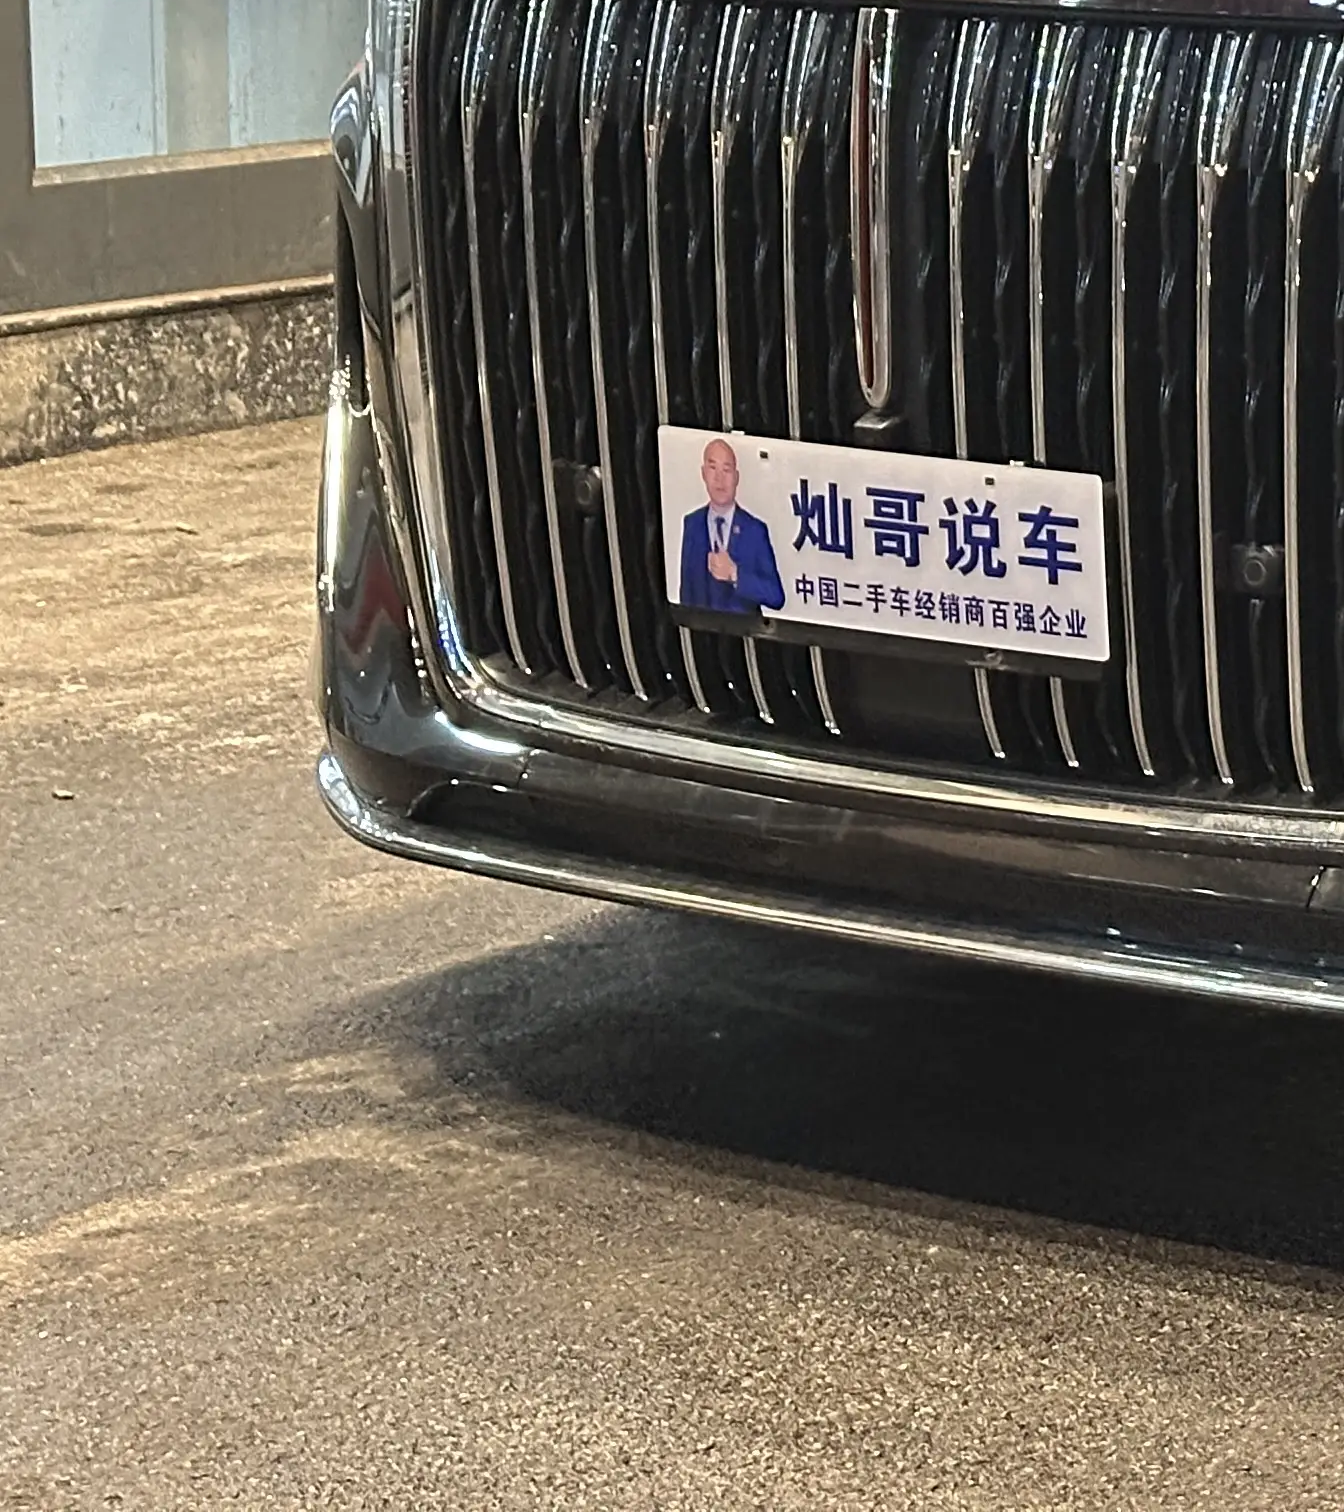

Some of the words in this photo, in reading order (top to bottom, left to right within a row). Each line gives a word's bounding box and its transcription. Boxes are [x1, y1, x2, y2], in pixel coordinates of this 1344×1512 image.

[790, 478, 1084, 585] 灿哥说车
[795, 573, 1088, 640] 中国二手车经销商百强企业
